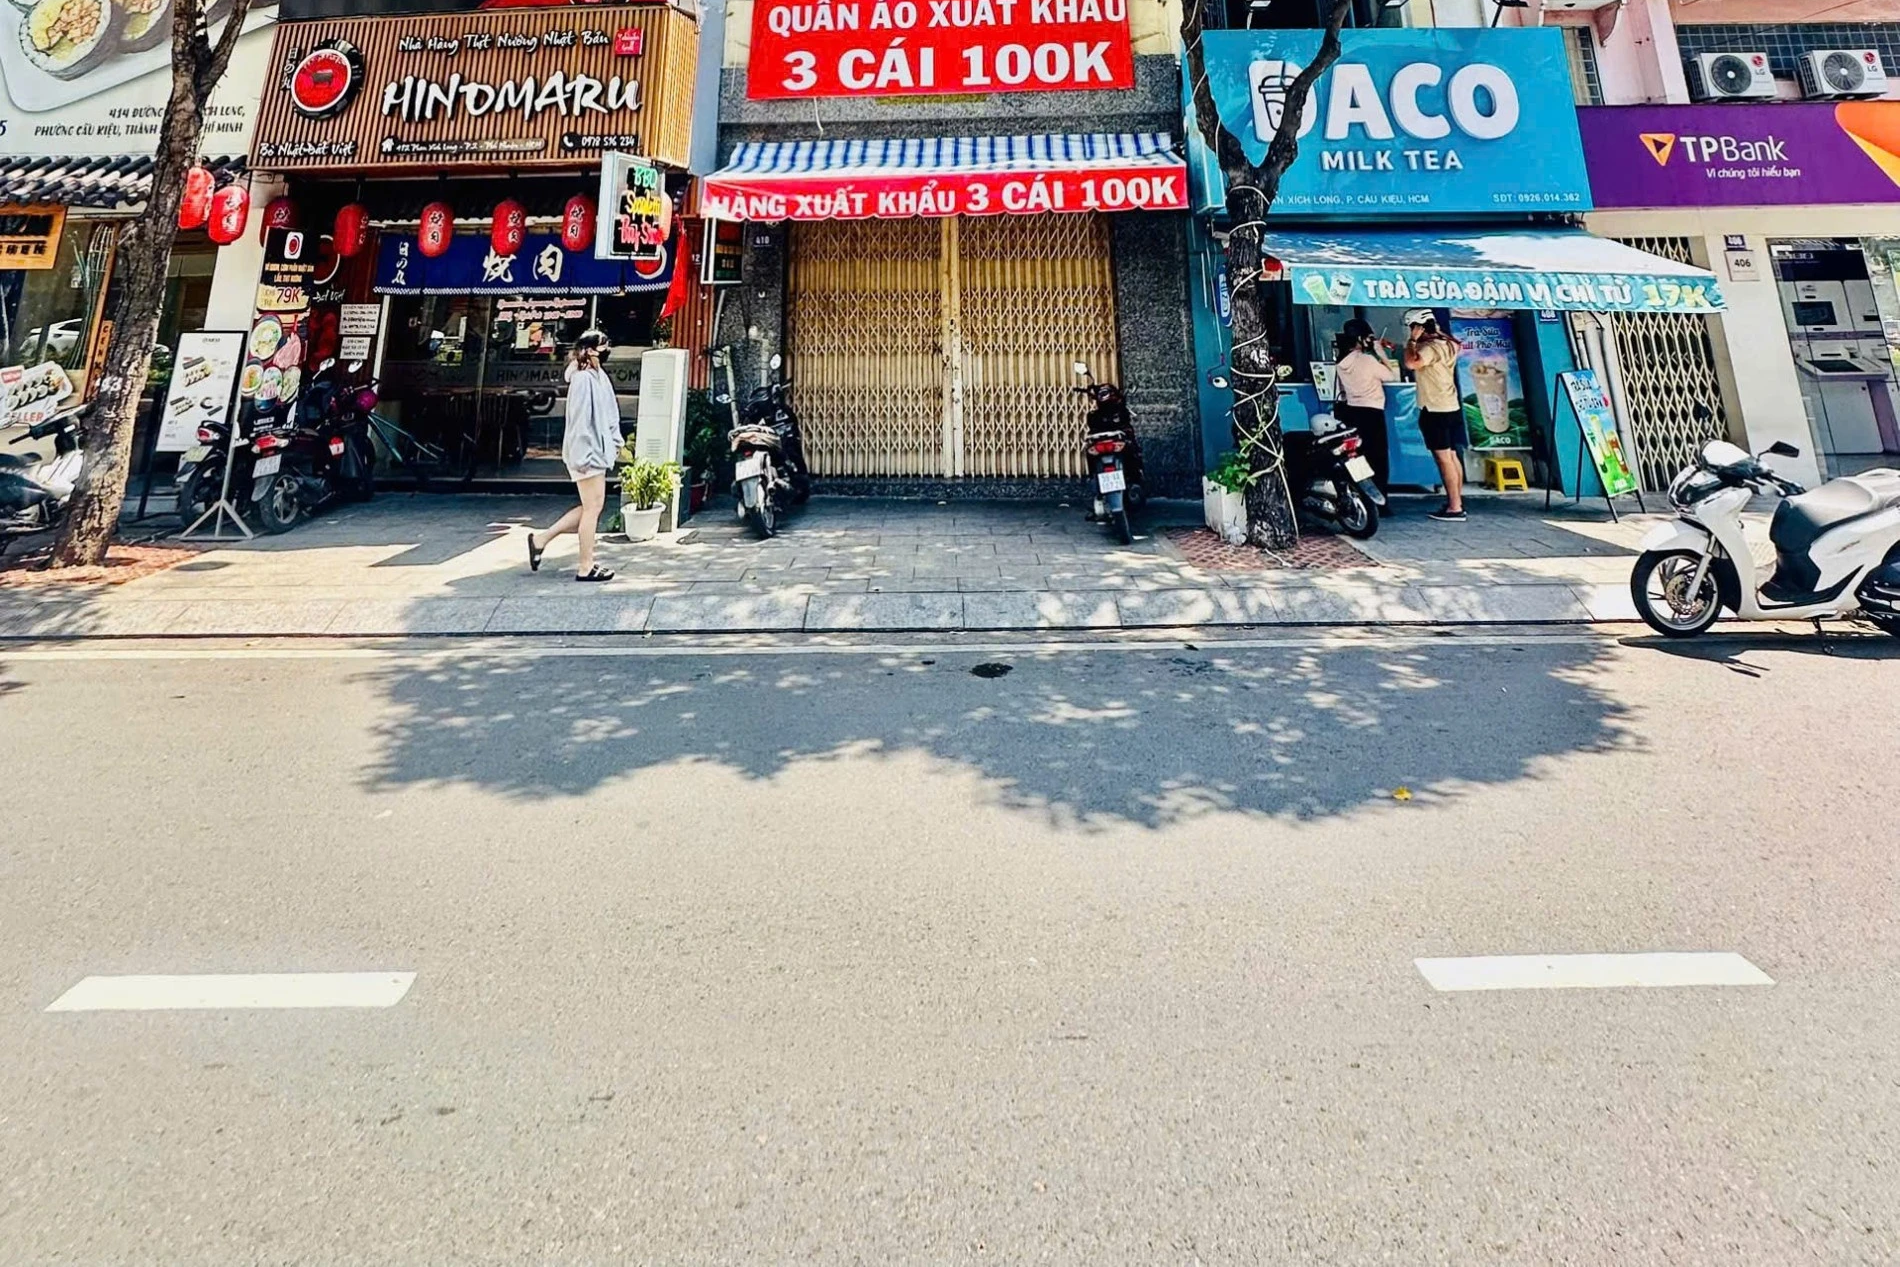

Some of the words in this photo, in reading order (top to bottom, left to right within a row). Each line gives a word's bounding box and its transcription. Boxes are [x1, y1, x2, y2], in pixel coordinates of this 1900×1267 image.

[399, 36, 424, 52] Nhà
[427, 37, 459, 55] Hàng
[463, 33, 493, 50] Thịt
[543, 30, 576, 47] Nhật
[781, 50, 817, 91] 3
[838, 37, 934, 89] CÁI
[961, 41, 1115, 86] 100K
[381, 70, 643, 122] HINOMARU
[1248, 60, 1519, 142] DACO
[109, 107, 130, 118] 414
[124, 122, 158, 135] THÀNH
[218, 122, 244, 133] MINH
[260, 142, 275, 156] Bò
[331, 140, 356, 156] Việt
[603, 135, 618, 146] 516
[620, 135, 635, 146] 234
[1679, 135, 1790, 162] TPBank
[1320, 150, 1394, 171] MILK
[1403, 149, 1464, 171] TEA
[1718, 166, 1746, 180] chúng
[712, 190, 787, 217] HÀNG
[794, 184, 869, 216] XUẤT
[878, 179, 956, 214] KHẨU
[965, 182, 989, 212] 3
[1003, 173, 1065, 209] CÁI
[1081, 175, 1178, 207] 100K
[1408, 193, 1430, 204] HCM
[1734, 258, 1751, 268] 406
[276, 287, 301, 304] 79K
[1363, 275, 1410, 301] TRÀ
[1414, 276, 1466, 302] SỮA
[1598, 275, 1632, 305] TỪ
[1641, 283, 1709, 308] 17K
